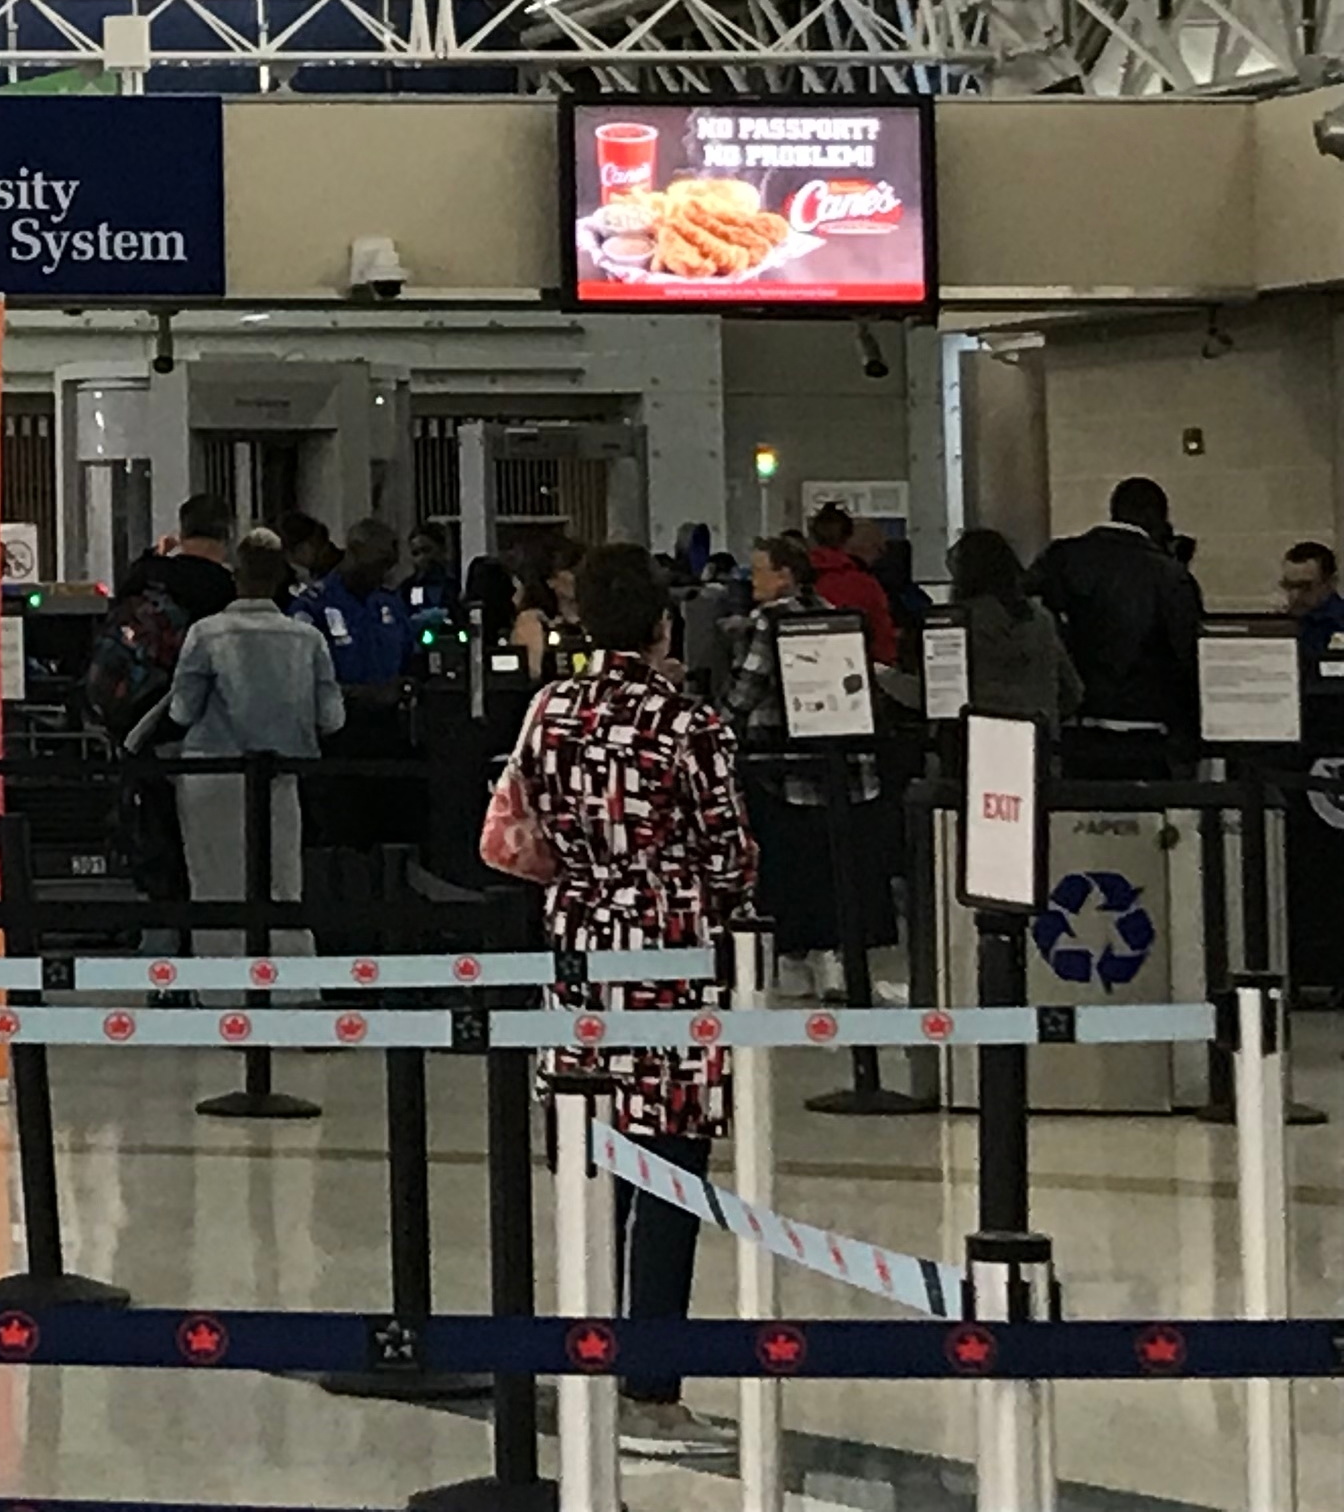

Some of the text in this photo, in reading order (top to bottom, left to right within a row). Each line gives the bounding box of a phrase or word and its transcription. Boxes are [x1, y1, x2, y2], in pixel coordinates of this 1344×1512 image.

[697, 117, 880, 140] NO PASSPORT?
[704, 145, 741, 167] NO
[11, 216, 188, 274] System
[983, 793, 1022, 822] EXIT
